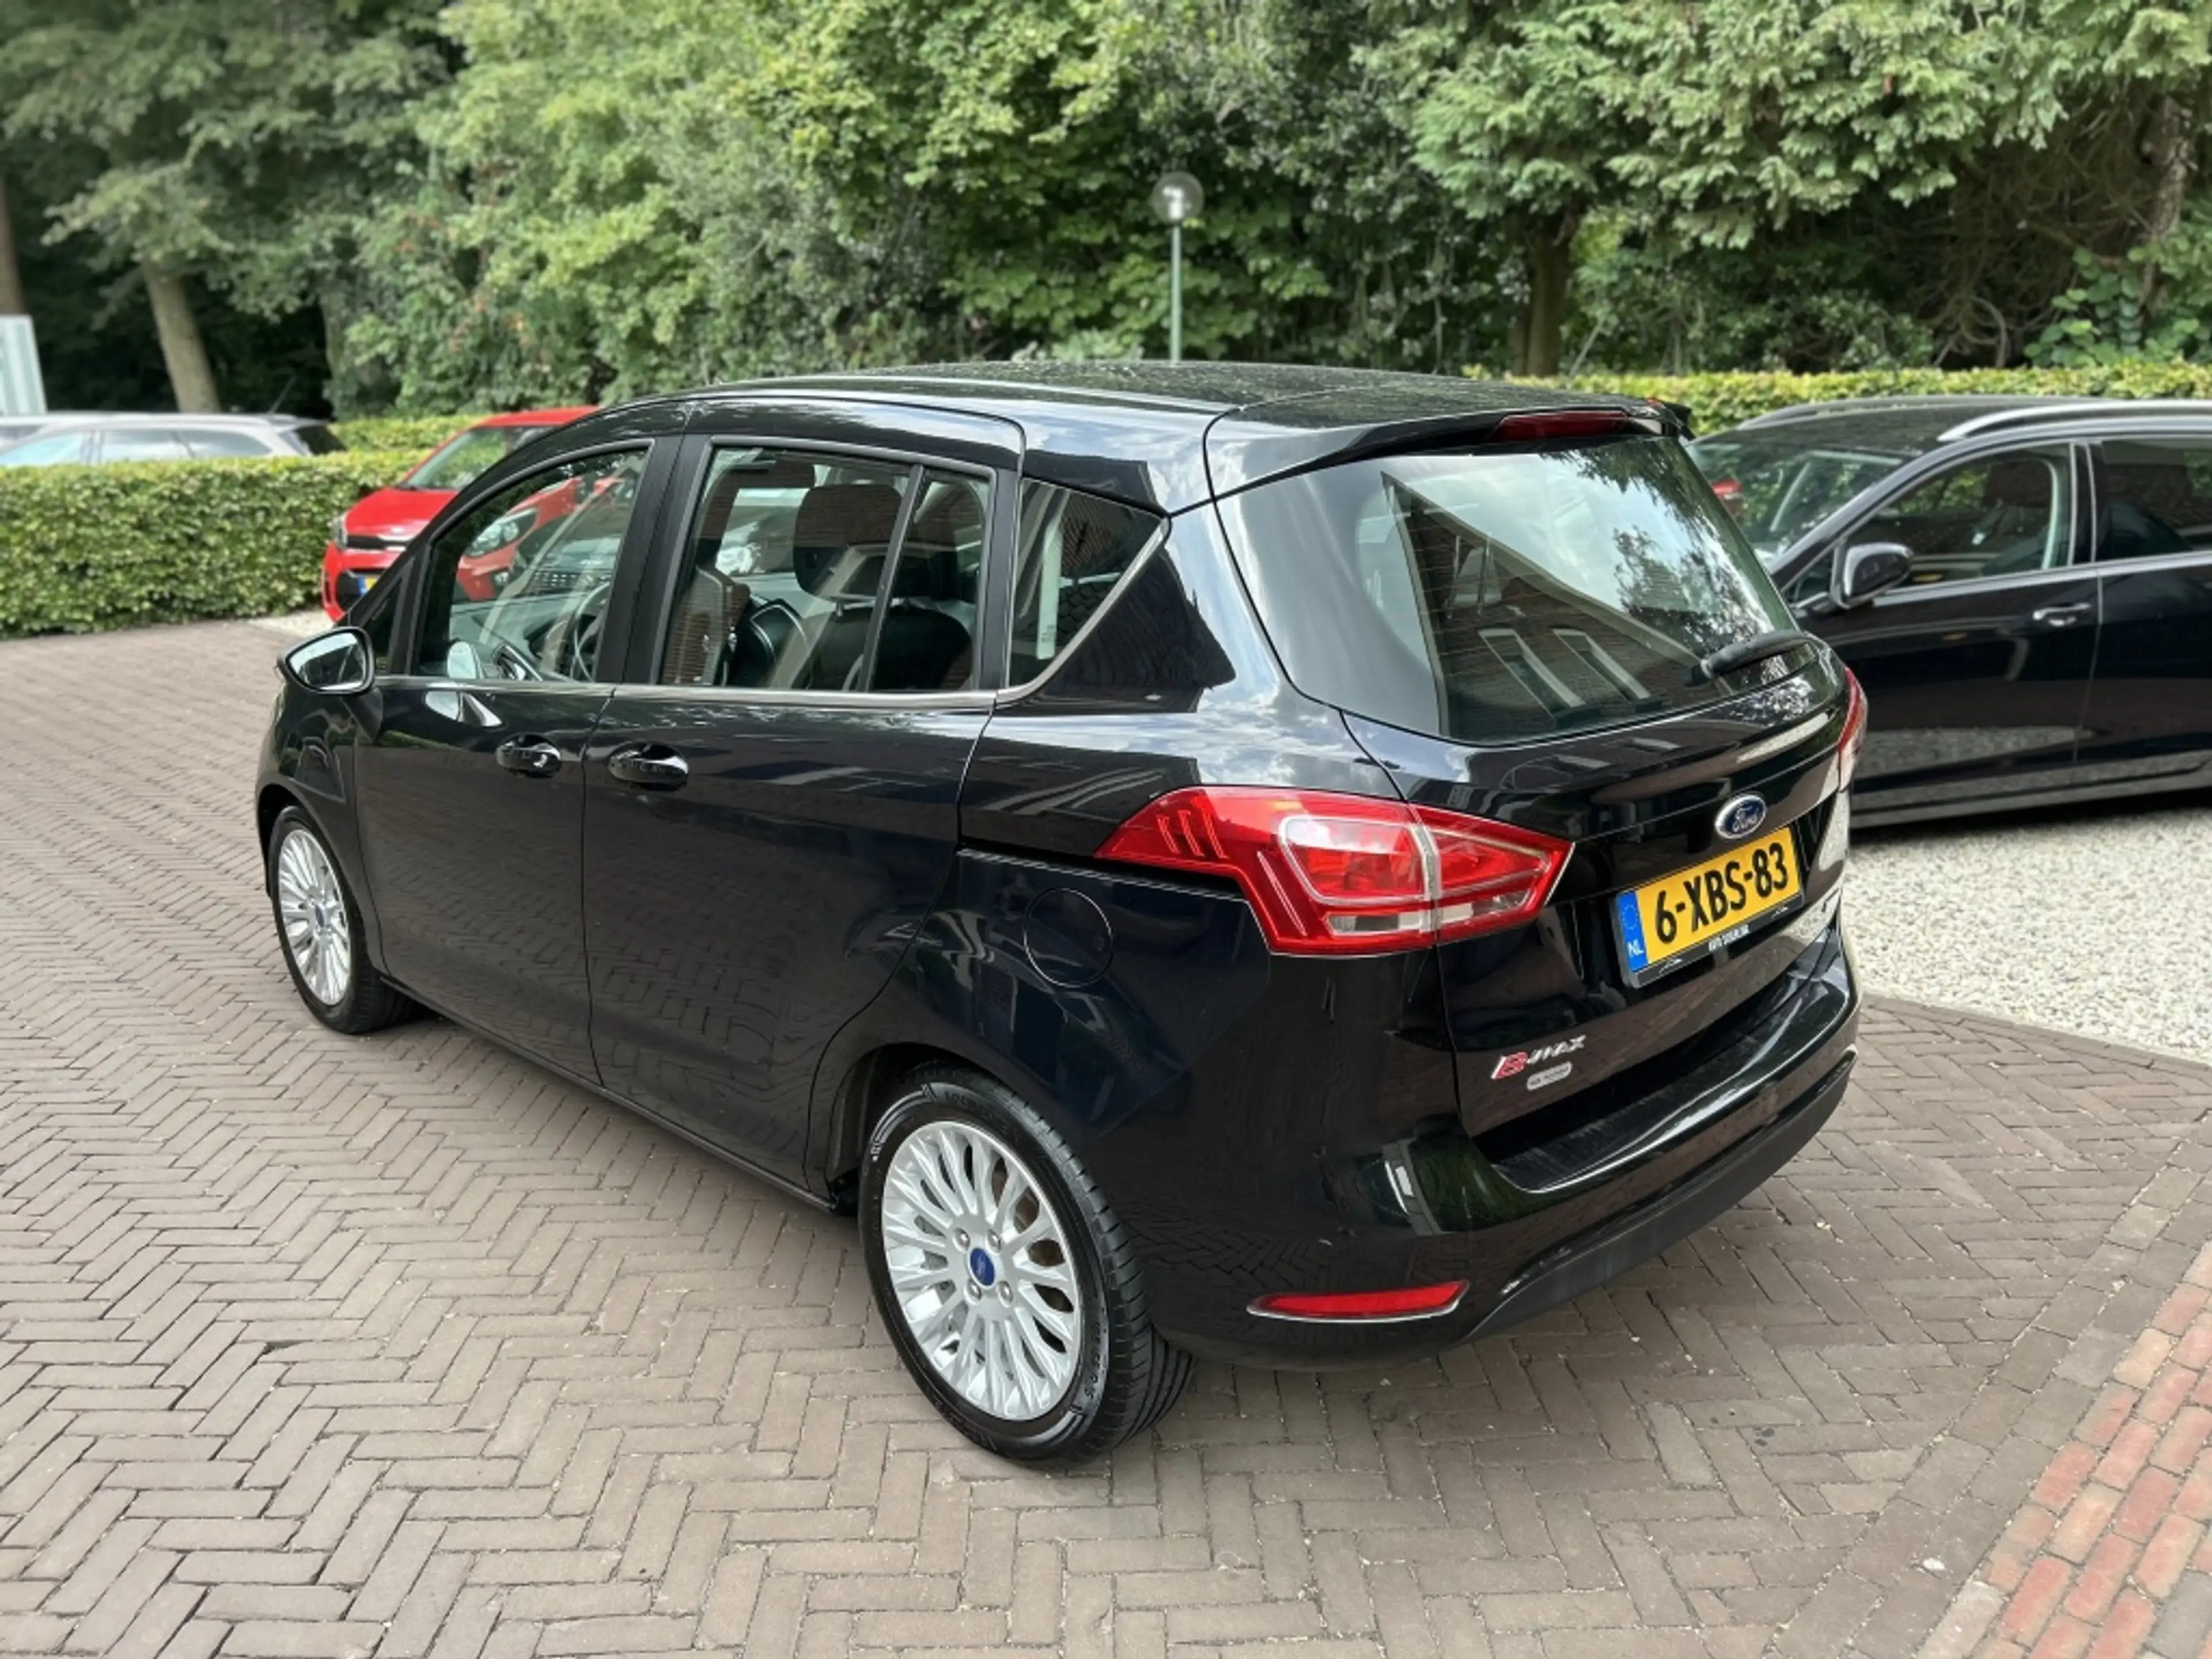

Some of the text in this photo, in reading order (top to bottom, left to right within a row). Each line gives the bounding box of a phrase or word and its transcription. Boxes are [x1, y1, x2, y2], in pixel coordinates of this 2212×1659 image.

[1730, 802, 1761, 833] Ford
[1655, 842, 1789, 944] 6-XBS-83
[1627, 938, 1644, 957] NL
